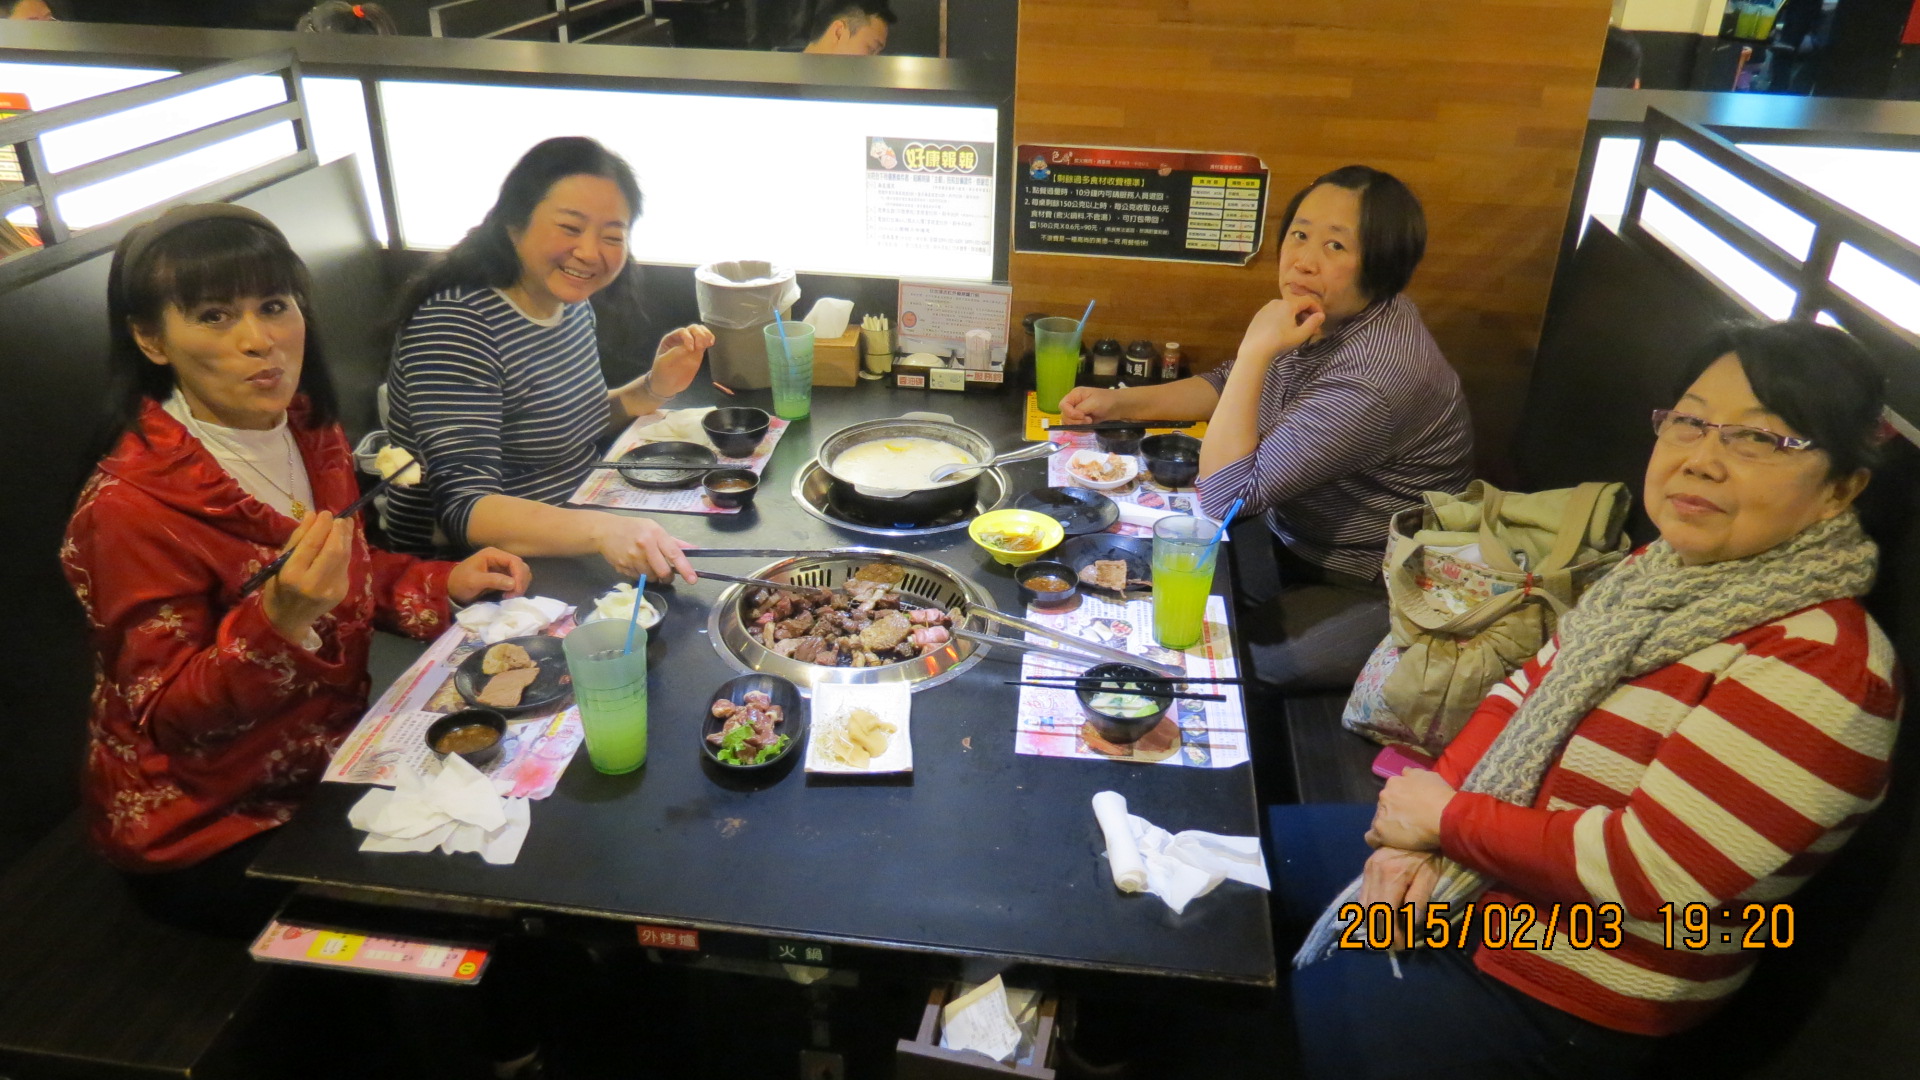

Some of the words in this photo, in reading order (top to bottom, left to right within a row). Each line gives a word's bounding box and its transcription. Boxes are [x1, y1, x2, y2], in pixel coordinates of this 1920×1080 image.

[905, 147, 975, 170] 好康報報
[779, 945, 823, 961] 火鍋
